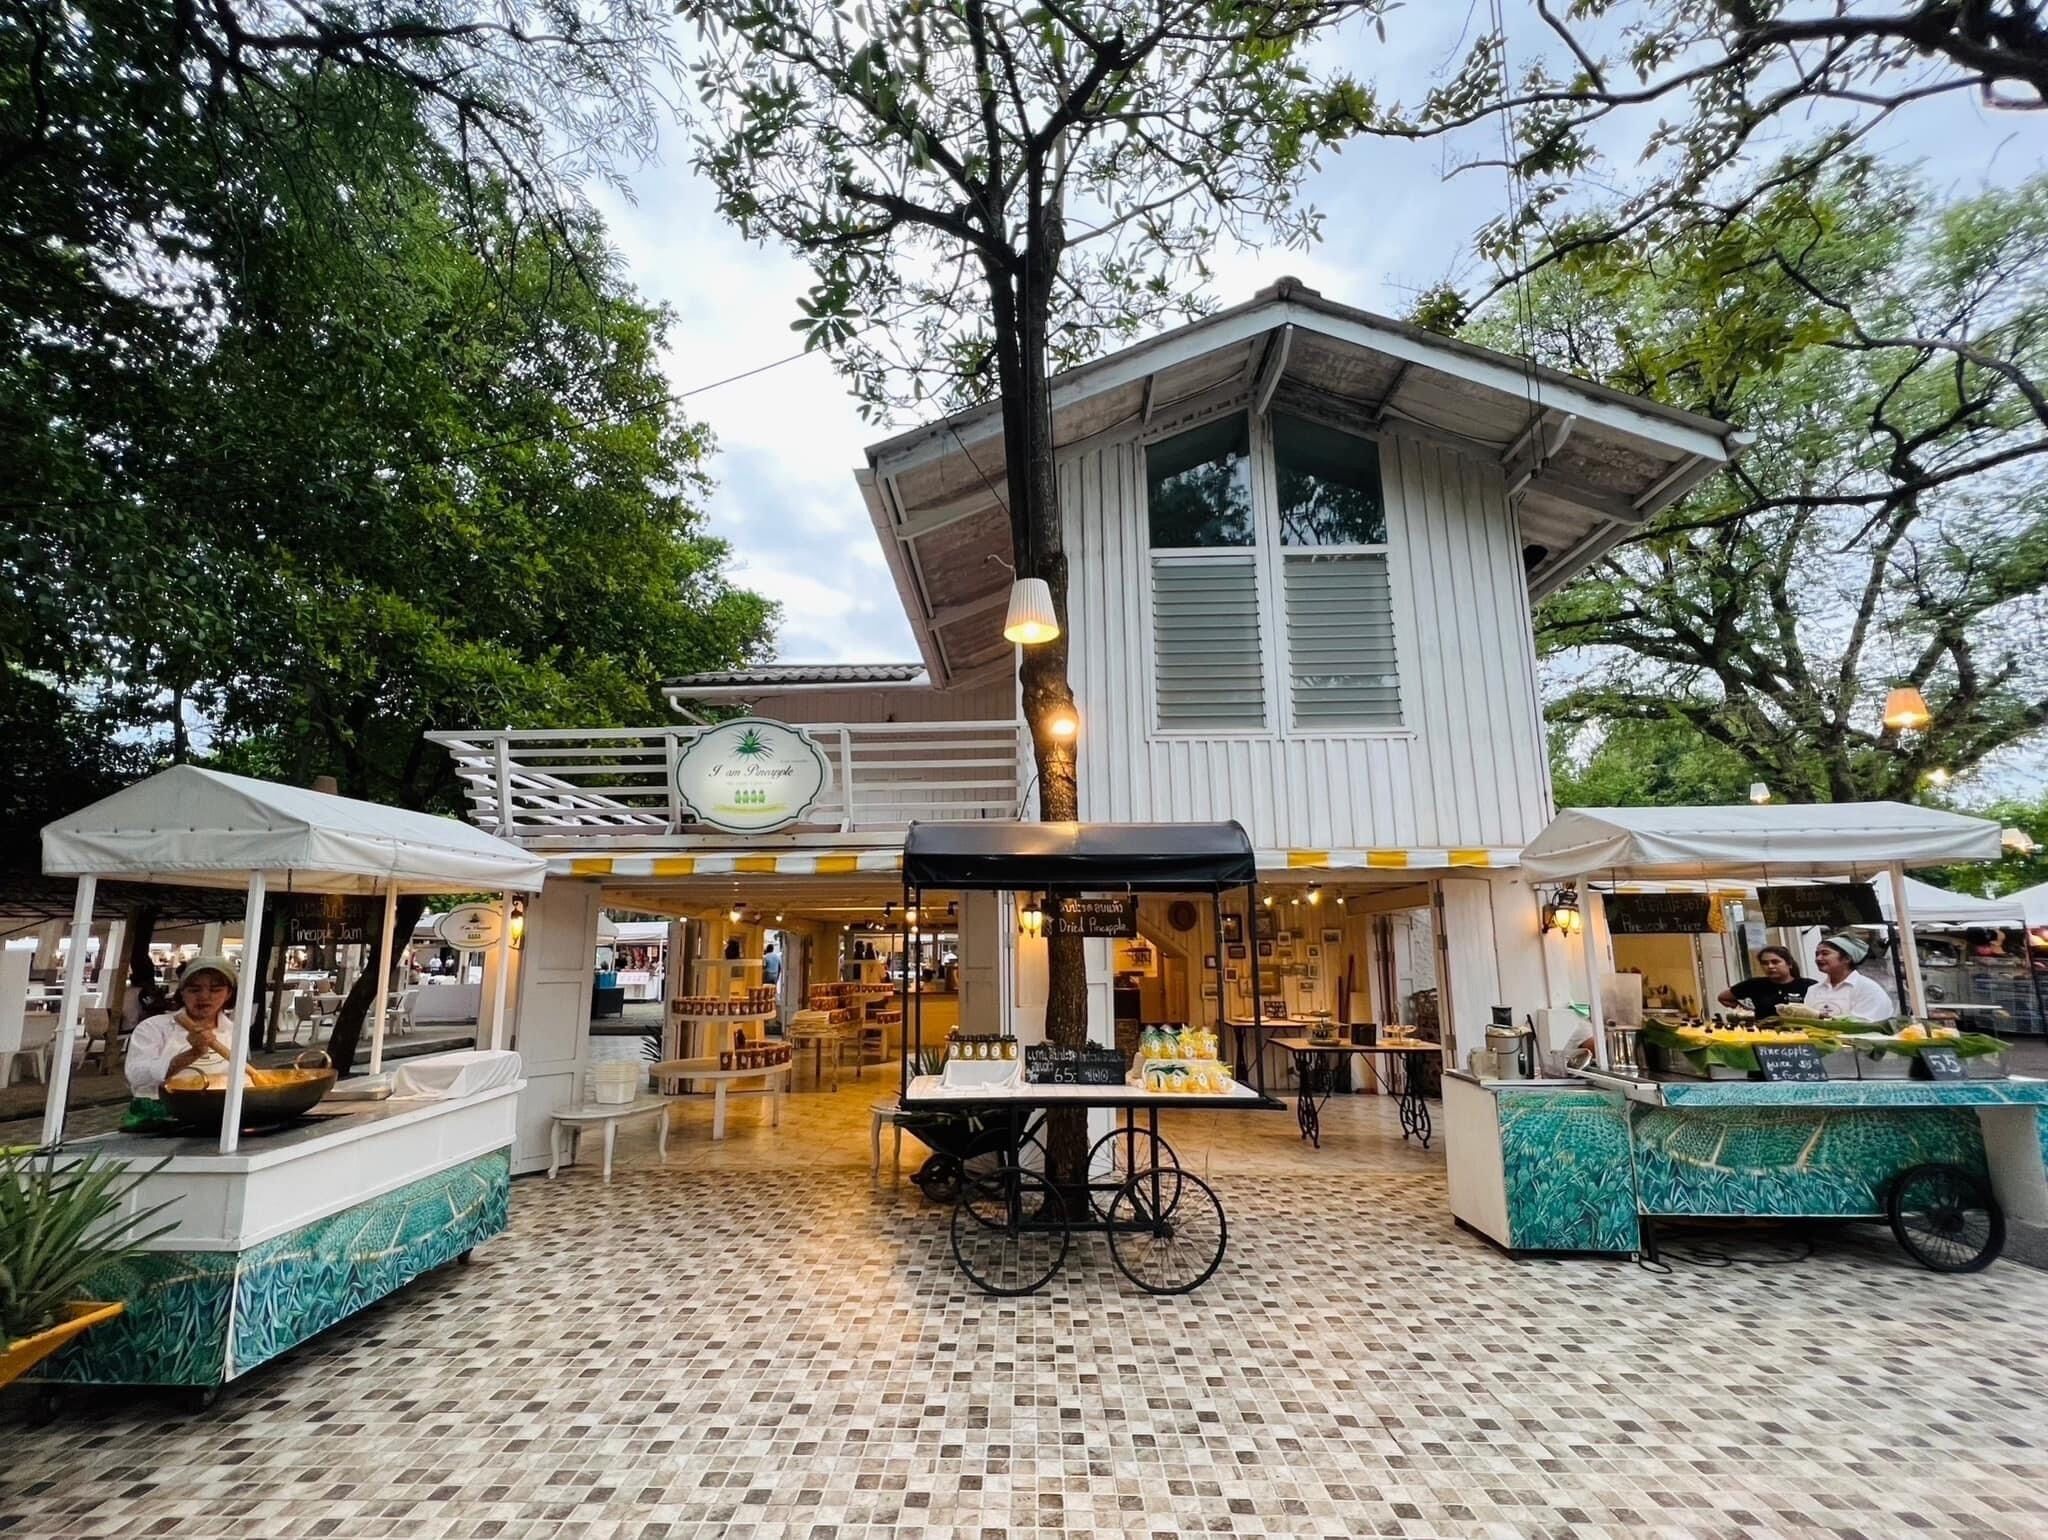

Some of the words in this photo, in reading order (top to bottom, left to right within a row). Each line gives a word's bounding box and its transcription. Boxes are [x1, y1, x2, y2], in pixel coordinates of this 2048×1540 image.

[708, 763, 724, 777] I
[726, 768, 742, 777] am
[744, 762, 795, 779] Pineapple
[291, 918, 334, 945] Pineapple
[337, 922, 362, 940] Jam
[1059, 915, 1084, 933] Dried
[1089, 916, 1127, 936] Pineapple
[1928, 1054, 1961, 1073] 55
